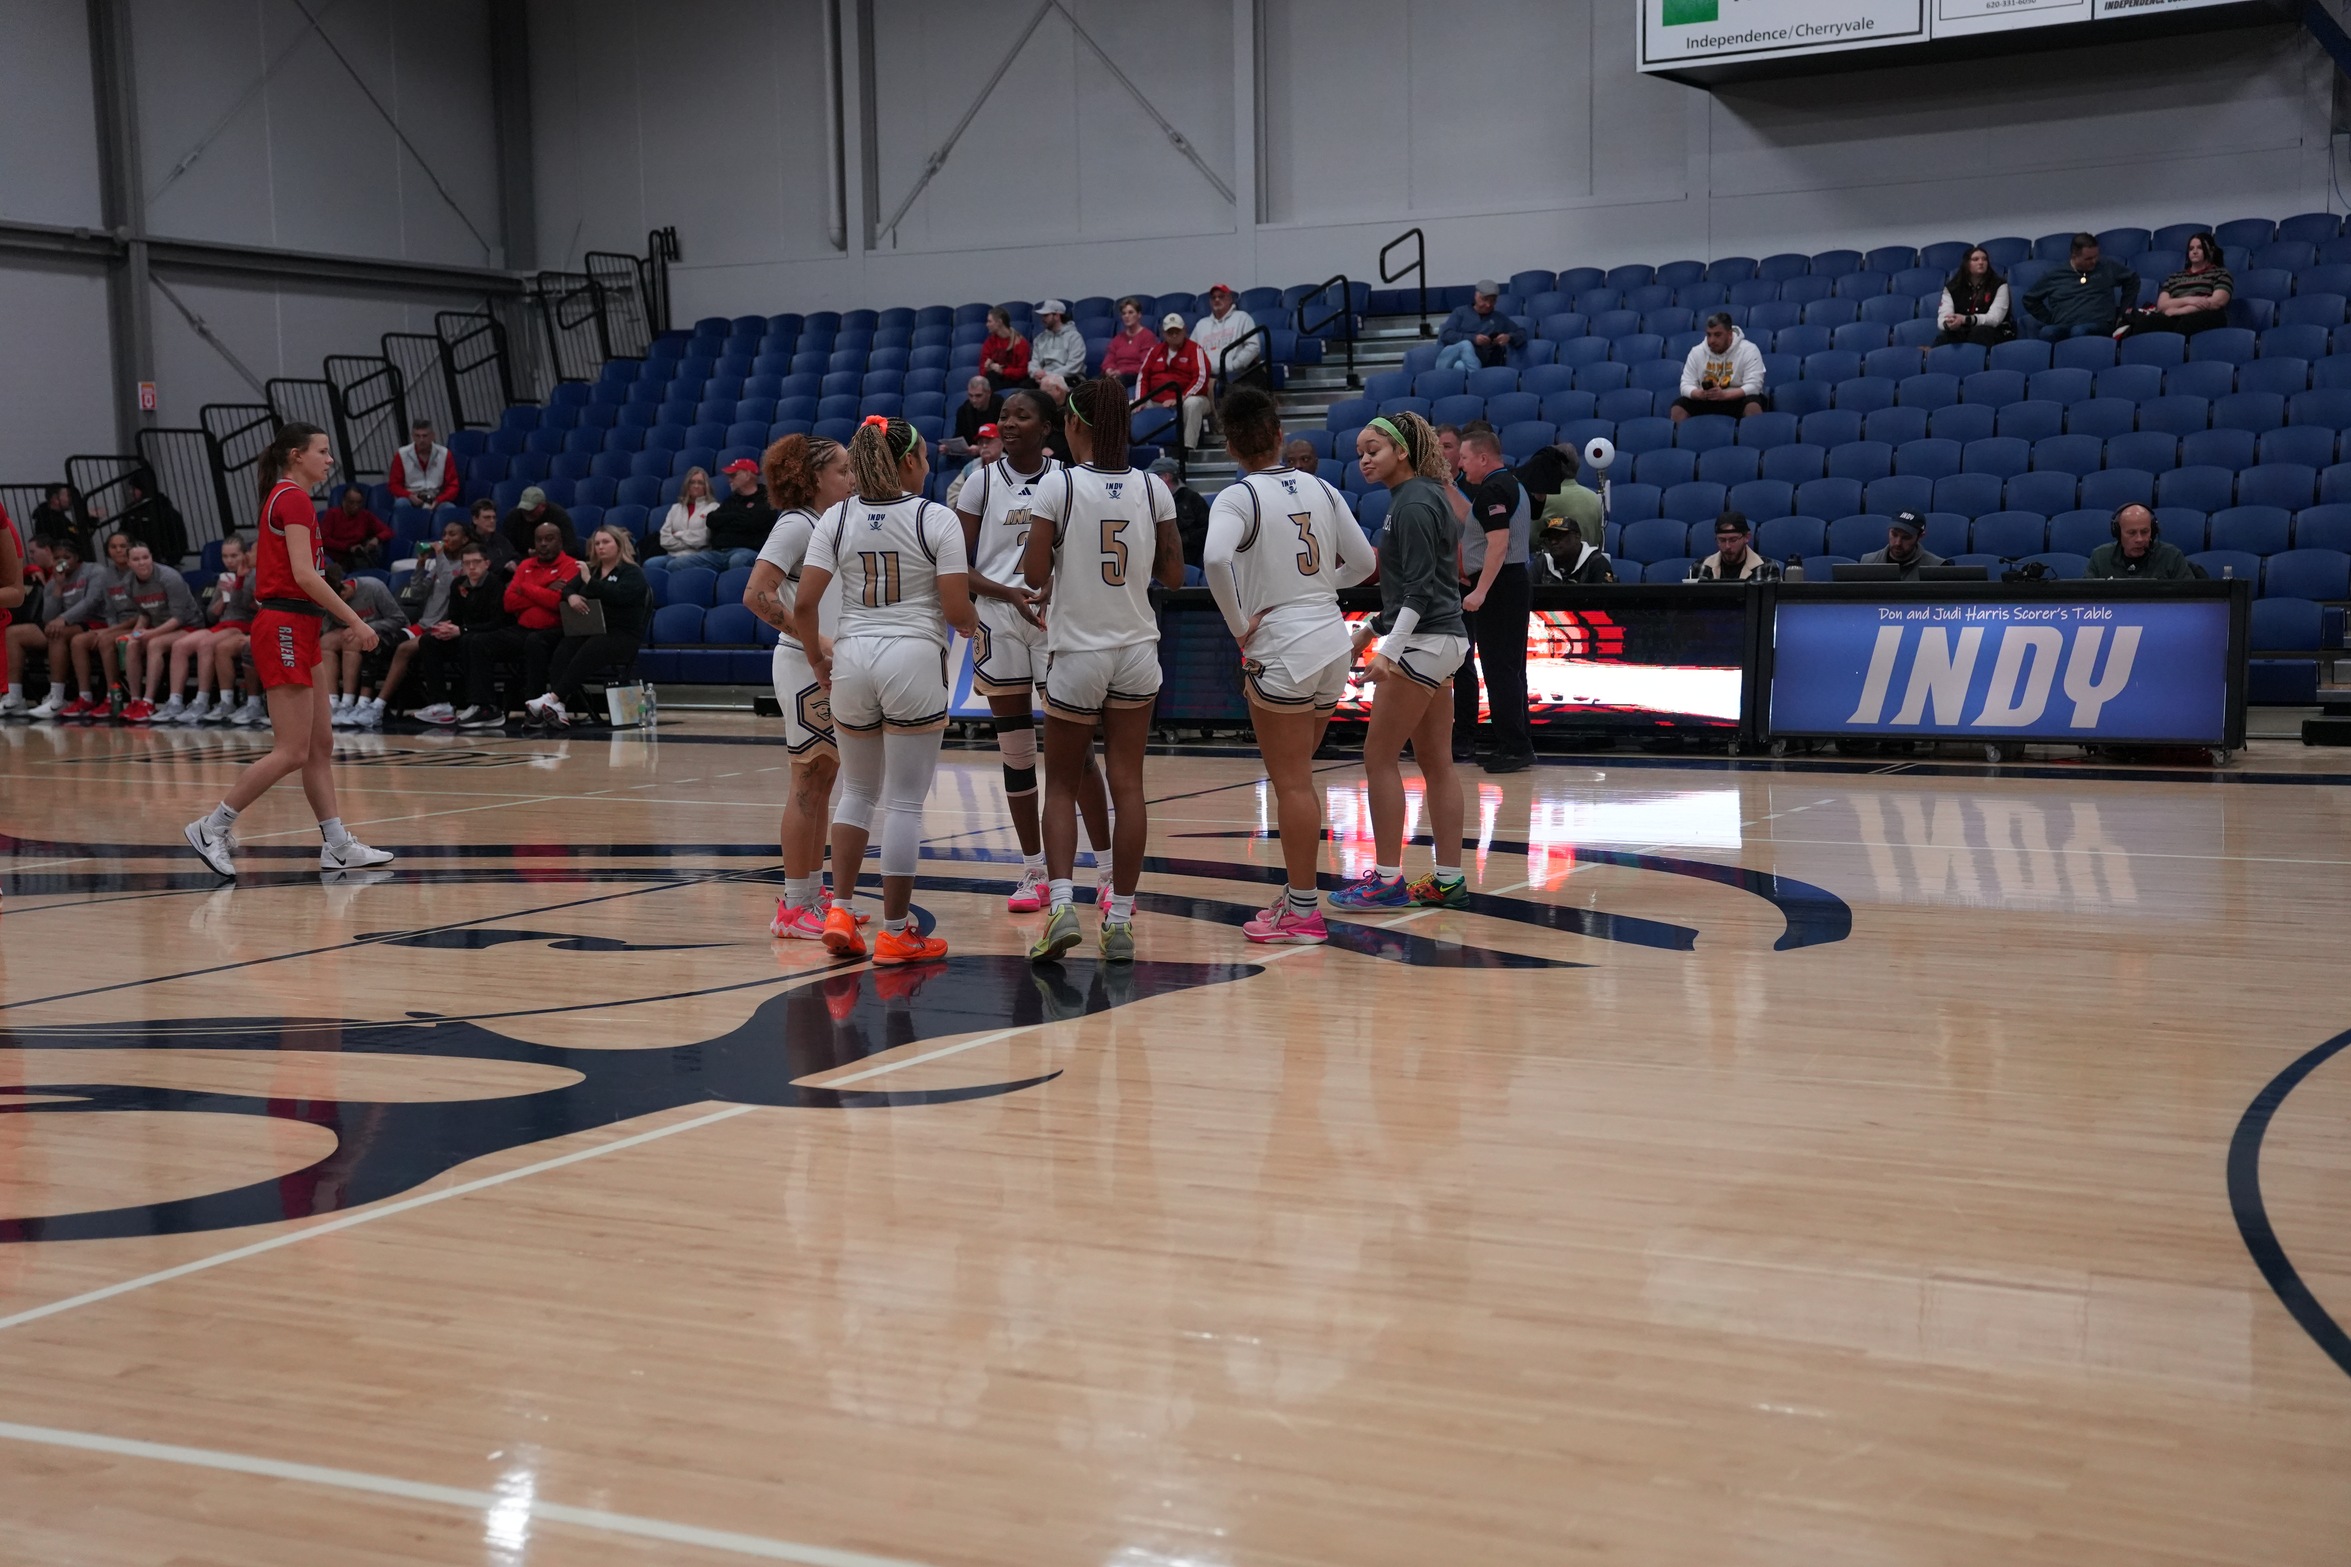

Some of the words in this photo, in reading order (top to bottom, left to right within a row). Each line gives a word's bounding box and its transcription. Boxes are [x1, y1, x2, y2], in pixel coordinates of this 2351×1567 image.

[1105, 482, 1123, 490] INDY
[1281, 478, 1297, 488] INDY
[867, 513, 886, 521] INDY
[1100, 519, 1130, 587] 5
[1287, 511, 1320, 577] 3
[857, 551, 901, 608] 11
[1879, 607, 1903, 621] Don
[1906, 607, 1930, 621] and
[1933, 607, 1962, 621] Judi
[1965, 605, 2010, 621] Harris
[2013, 606, 2068, 621] Scorer's
[2071, 607, 2113, 620] Table
[278, 626, 295, 668] RAVENS
[1845, 625, 2143, 729] INDY
